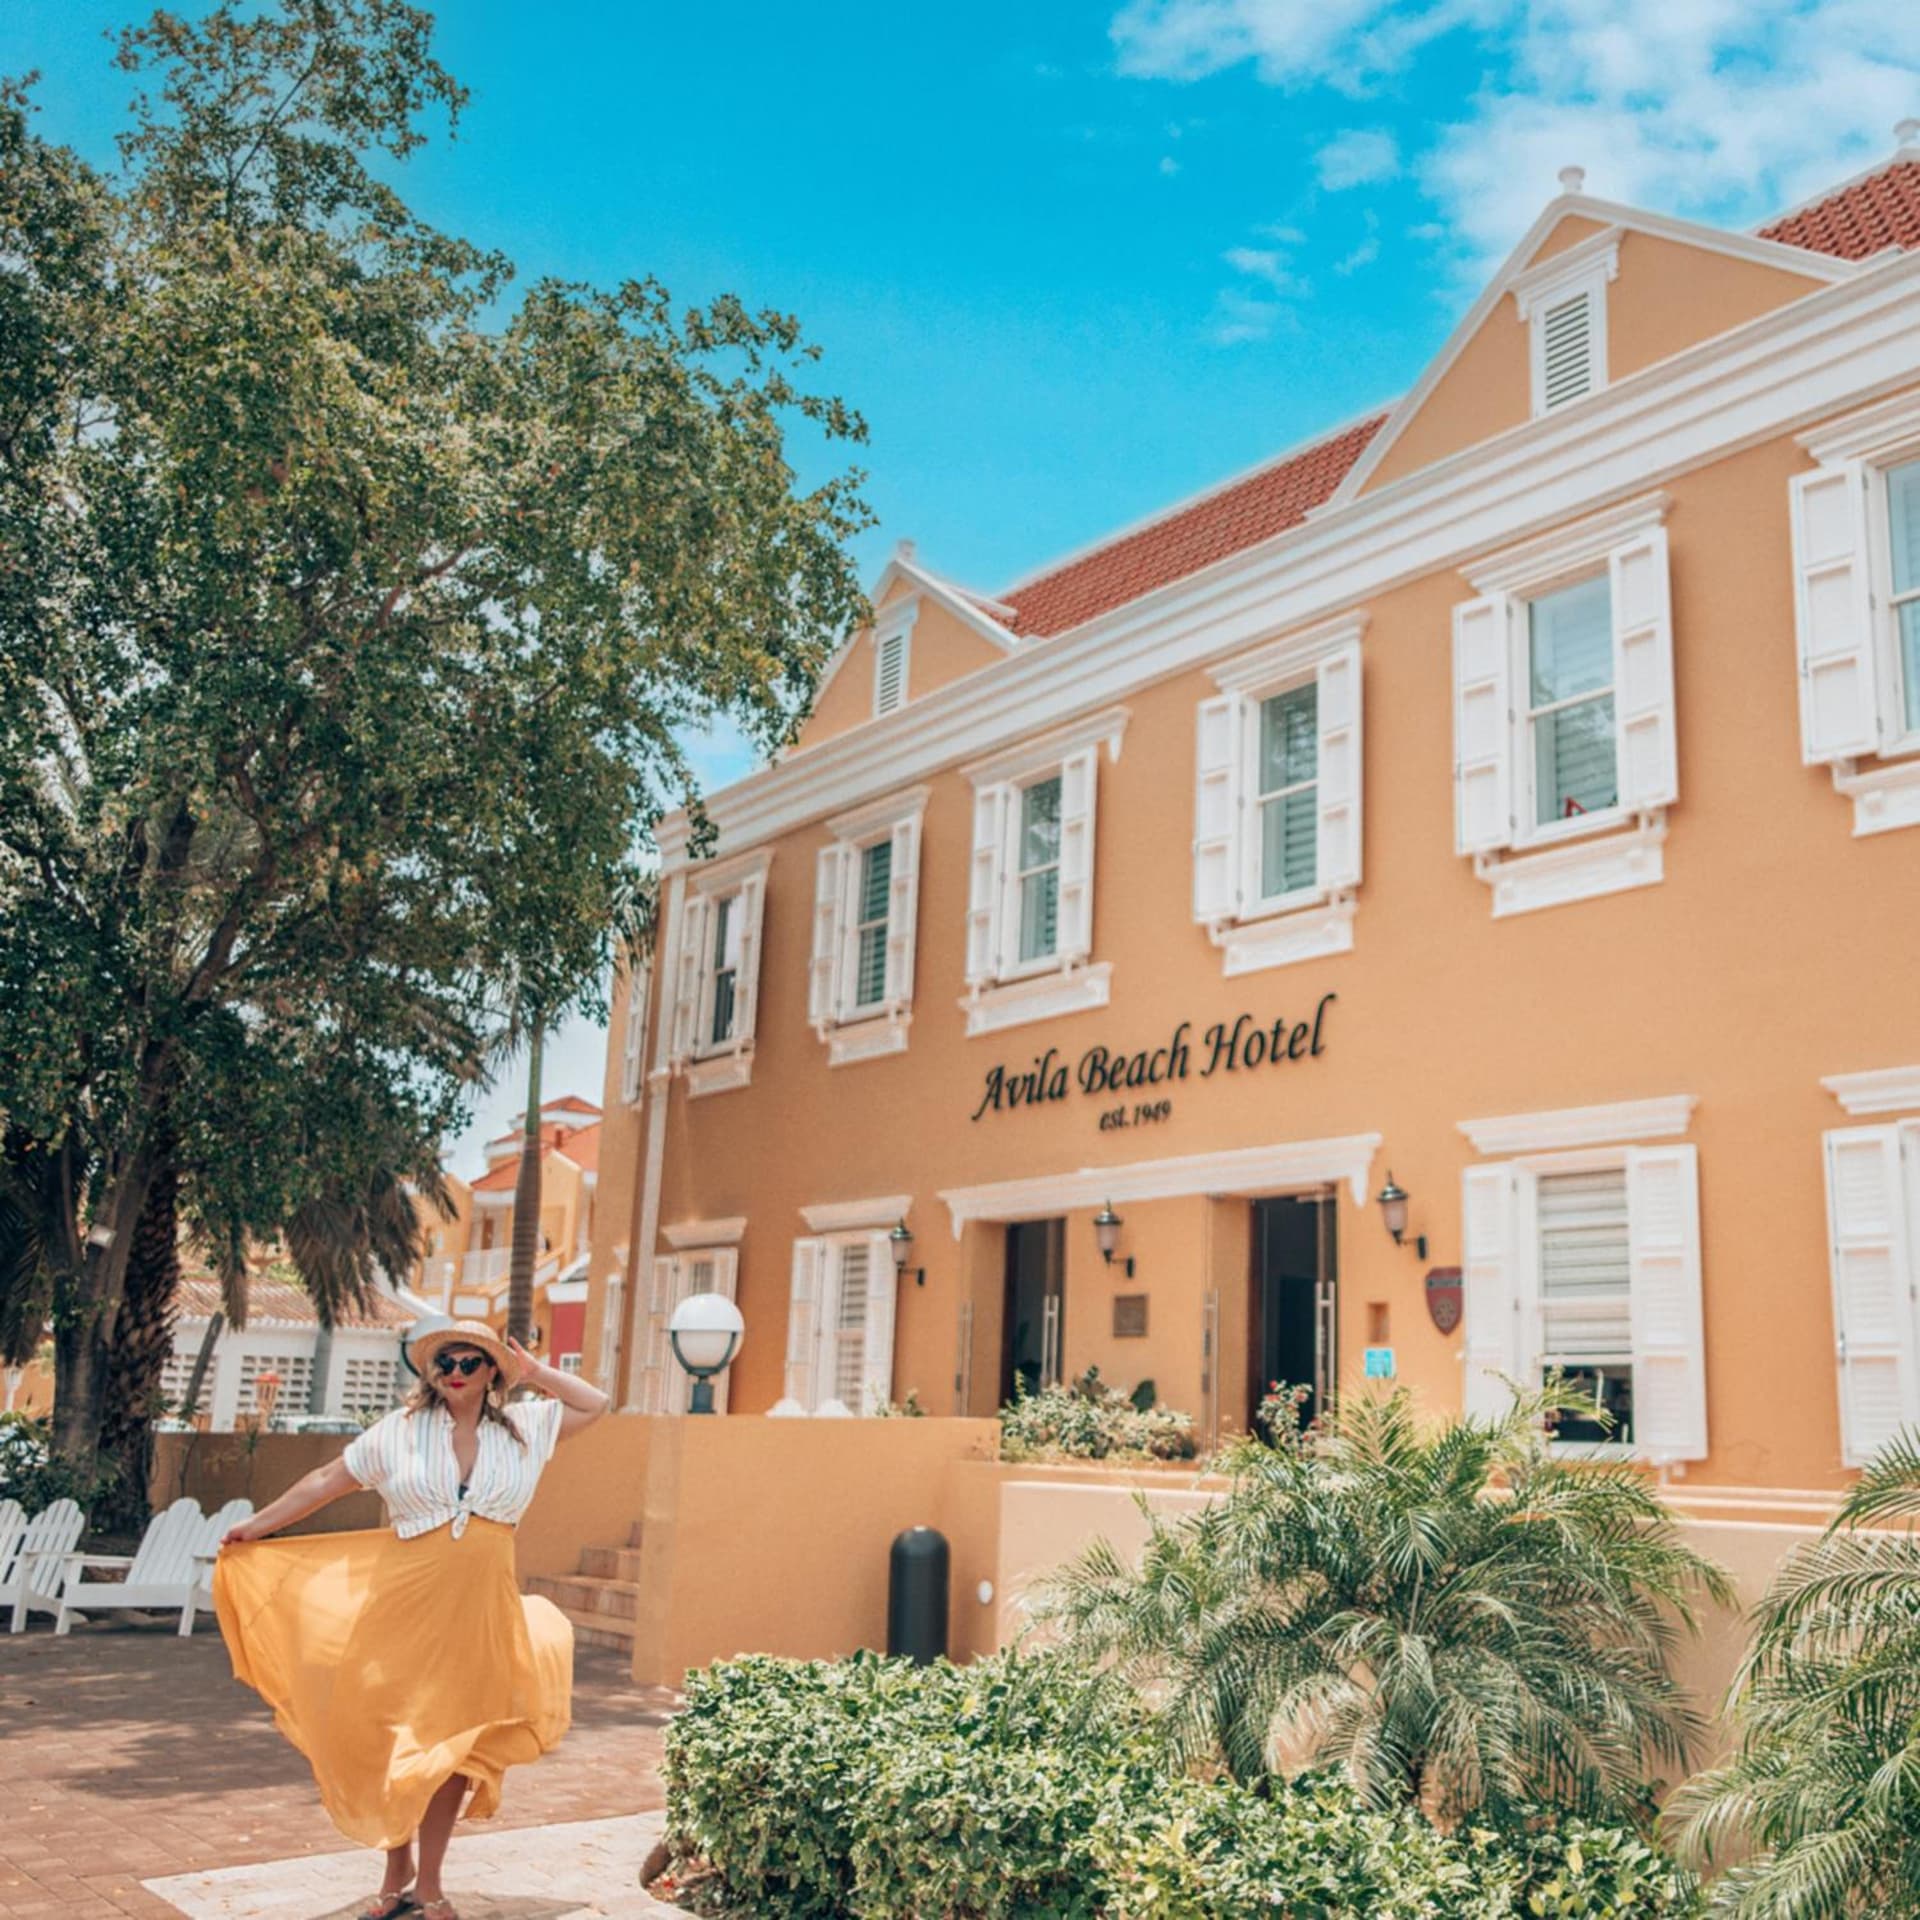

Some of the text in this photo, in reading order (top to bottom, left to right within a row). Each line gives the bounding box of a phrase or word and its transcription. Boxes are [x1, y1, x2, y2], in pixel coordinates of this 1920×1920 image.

[971, 993, 1337, 1121] Avila Beach Hotel
